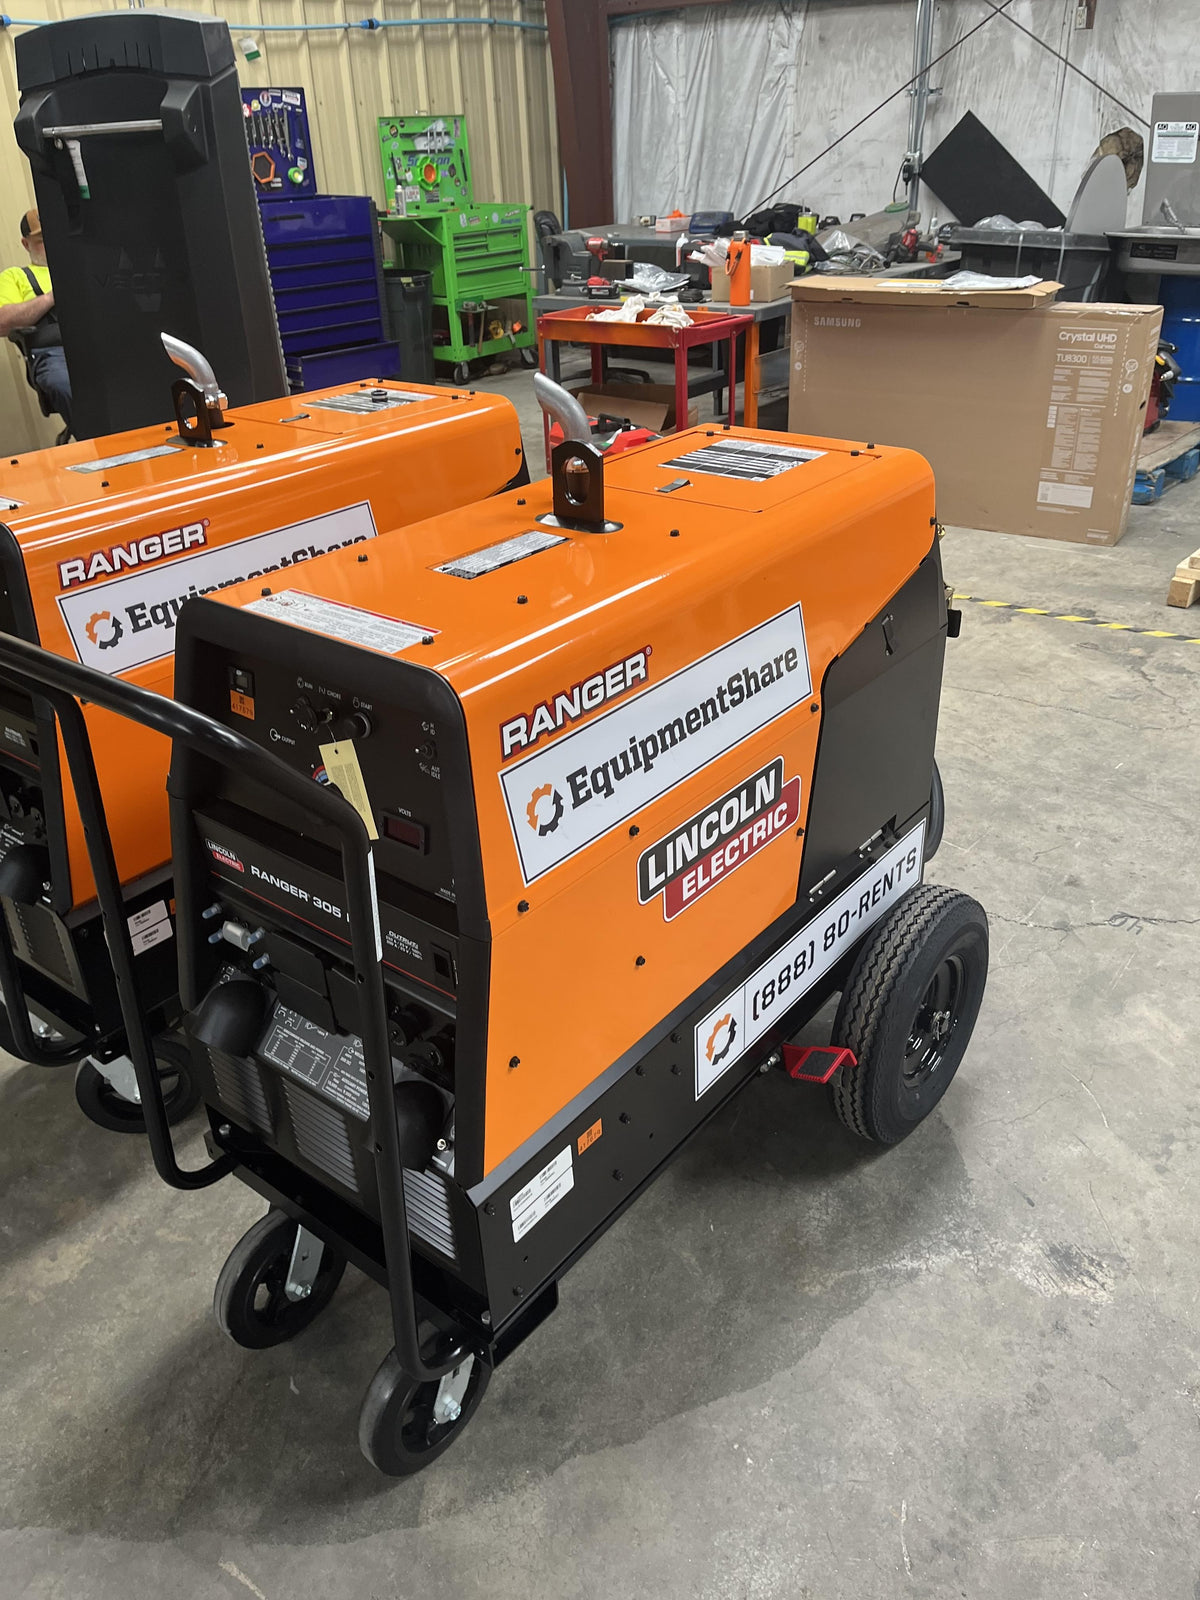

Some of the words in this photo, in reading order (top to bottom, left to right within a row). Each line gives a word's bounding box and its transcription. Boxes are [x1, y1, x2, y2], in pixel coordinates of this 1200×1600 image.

[814, 316, 862, 328] SAMSUNG
[1058, 331, 1095, 344] Crystal
[1096, 332, 1118, 343] UHD
[1056, 354, 1088, 364] TU8300
[565, 646, 799, 811] EquipmentShare
[398, 807, 412, 818] VOLTS
[647, 767, 776, 891] LINCOLN
[207, 841, 236, 861] LINCOLN
[682, 801, 788, 902] ELECTRIC
[215, 852, 242, 871] ELECTRIC
[250, 865, 310, 903] RANGER
[312, 896, 343, 919] 305
[752, 939, 815, 1022] (888)
[823, 846, 918, 952] 80-RENTS
